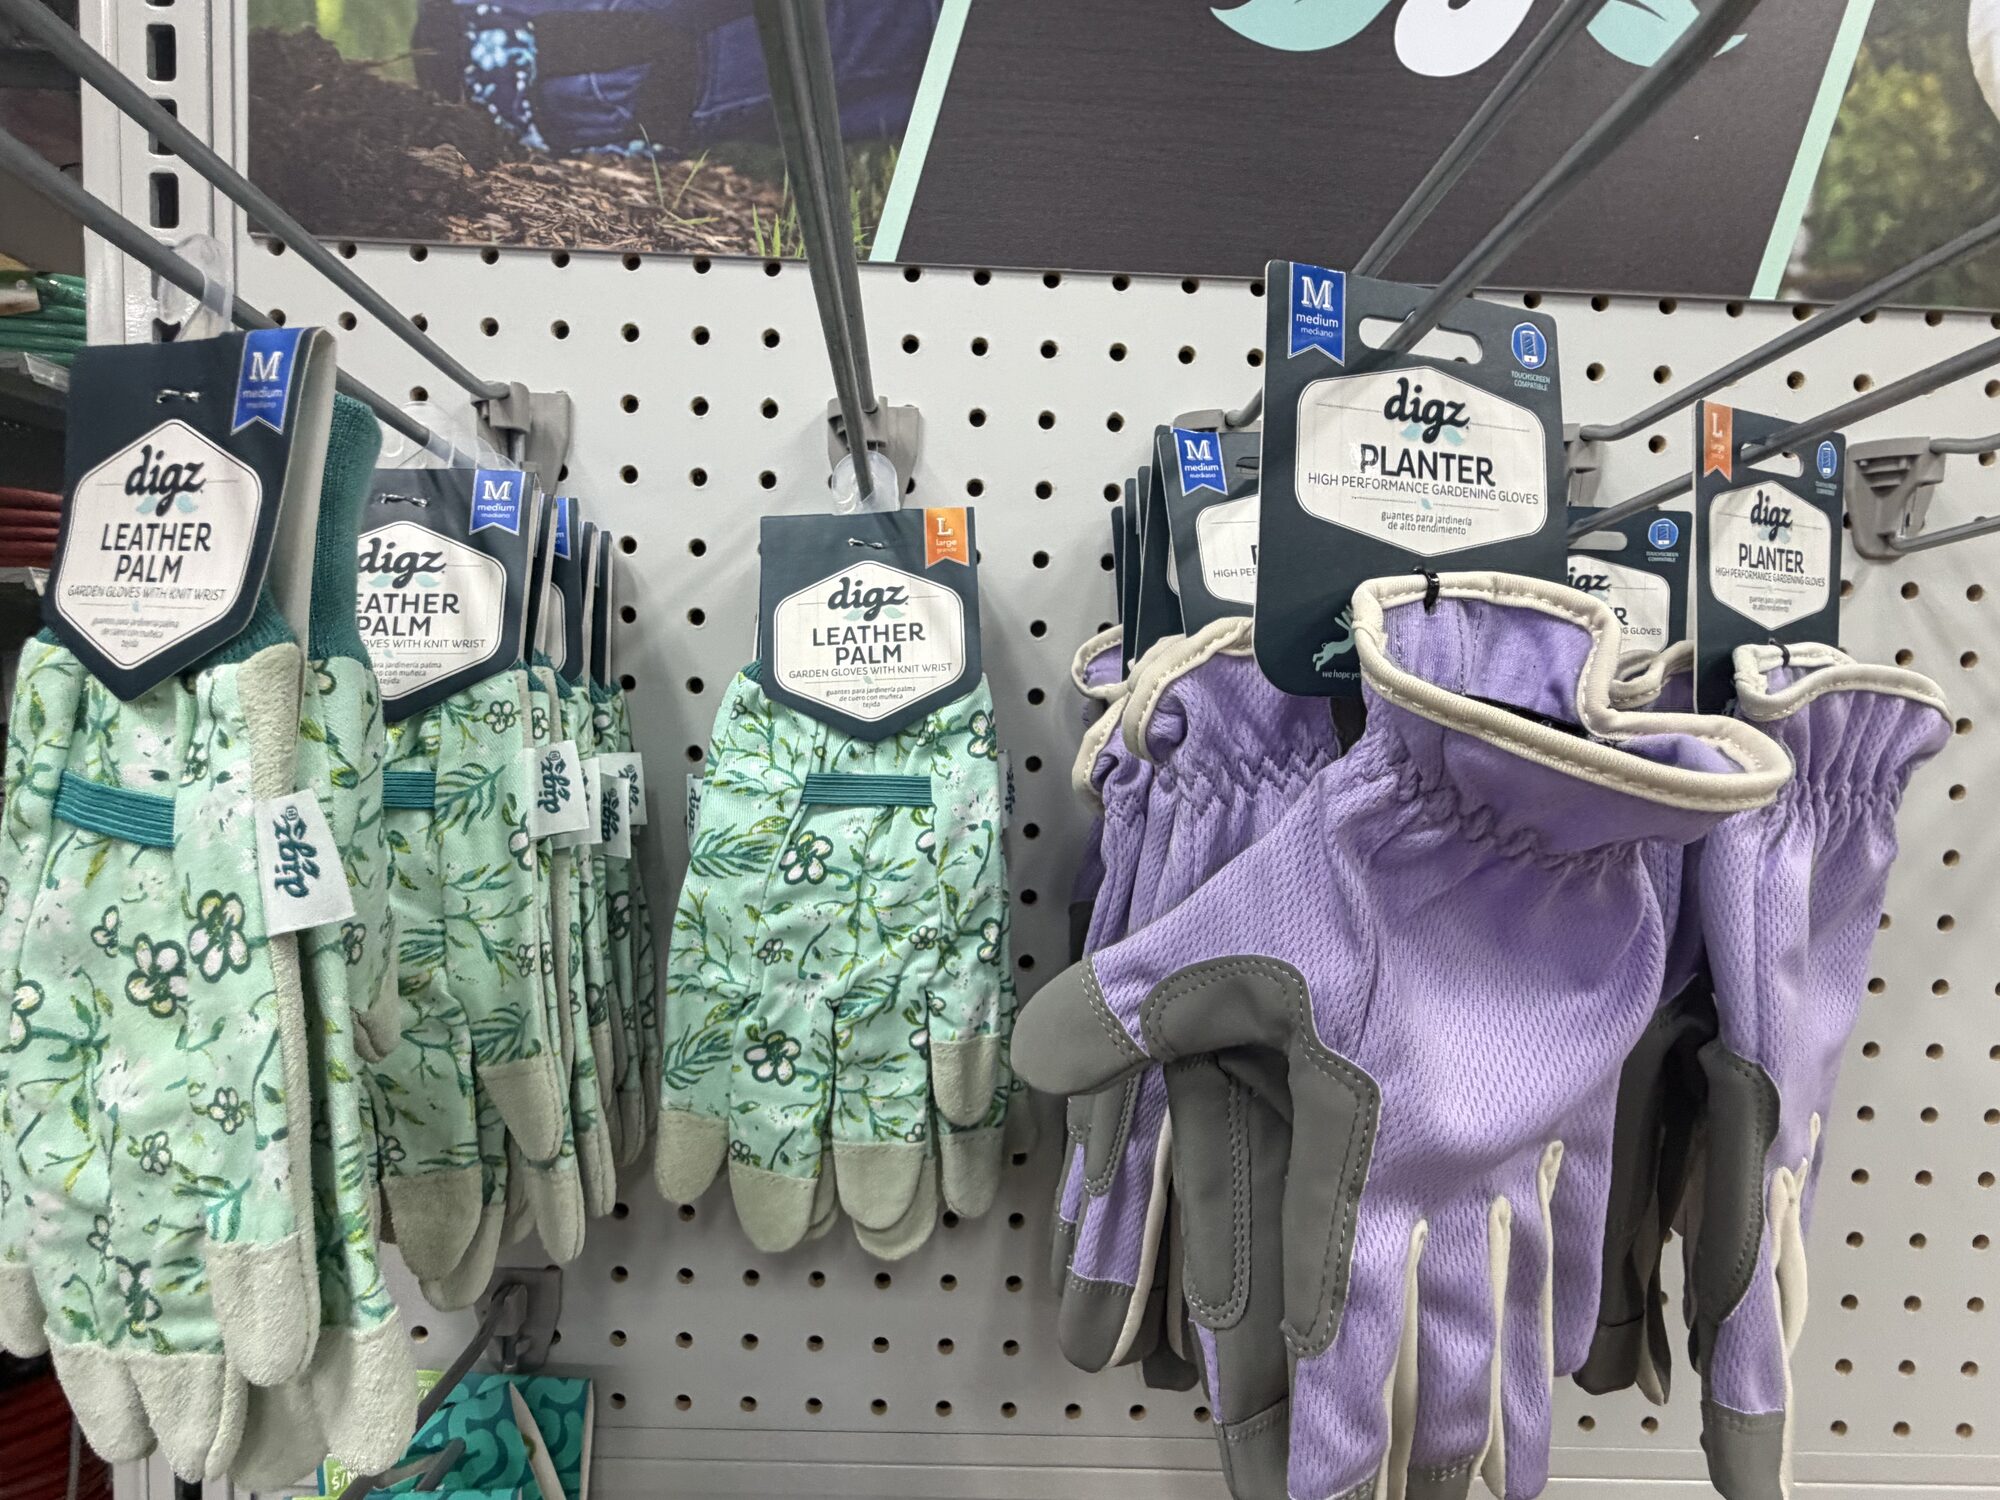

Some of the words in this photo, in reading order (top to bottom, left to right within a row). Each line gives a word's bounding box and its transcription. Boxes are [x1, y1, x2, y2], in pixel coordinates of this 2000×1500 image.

[1301, 276, 1334, 312] M
[1296, 313, 1339, 328] medium
[1300, 327, 1334, 338] mediano
[249, 351, 284, 382] M
[1384, 377, 1470, 443] digz
[1712, 412, 1723, 438] L
[1184, 440, 1213, 460] M
[1185, 462, 1219, 472] medium
[1360, 443, 1496, 487] PLANTER
[125, 444, 206, 517] digz
[482, 480, 512, 500] M
[1308, 473, 1339, 487] HIGH
[1342, 475, 1430, 495] PERFORMANCE
[1431, 484, 1502, 502] GARDENING
[1498, 491, 1539, 505] GLOVES
[477, 503, 515, 512] medium
[1381, 511, 1414, 522] guantes
[1416, 514, 1434, 524] para
[1750, 489, 1793, 542] digz
[100, 523, 212, 552] LEATHER
[936, 517, 954, 537] L
[1388, 521, 1398, 530] de
[1400, 521, 1417, 531] alto
[1418, 523, 1467, 535] rendimiento
[114, 555, 184, 583] PALM
[359, 537, 447, 589] digz
[1738, 543, 1804, 574] PLANTER
[1213, 569, 1239, 579] HIGH
[67, 584, 104, 597] GARDEN
[105, 585, 141, 598] GLOVES
[143, 586, 167, 598] WITH
[194, 588, 227, 601] WRIST
[827, 577, 909, 621] digz
[357, 615, 432, 637] PALM
[812, 622, 926, 646] LEATHER
[1630, 627, 1662, 636] GLOVES
[393, 639, 421, 648] WITH
[423, 639, 449, 648] KNIT
[452, 639, 486, 649] WRIST
[835, 644, 902, 665] PALM
[788, 668, 829, 679] GARDEN
[831, 666, 868, 677] GLOVES
[870, 665, 896, 675] WITH
[897, 664, 920, 674] KNIT
[921, 662, 953, 673] WRIST
[852, 688, 866, 696] para
[897, 686, 916, 694] palma
[537, 757, 571, 813] digz
[273, 814, 320, 898] digz
